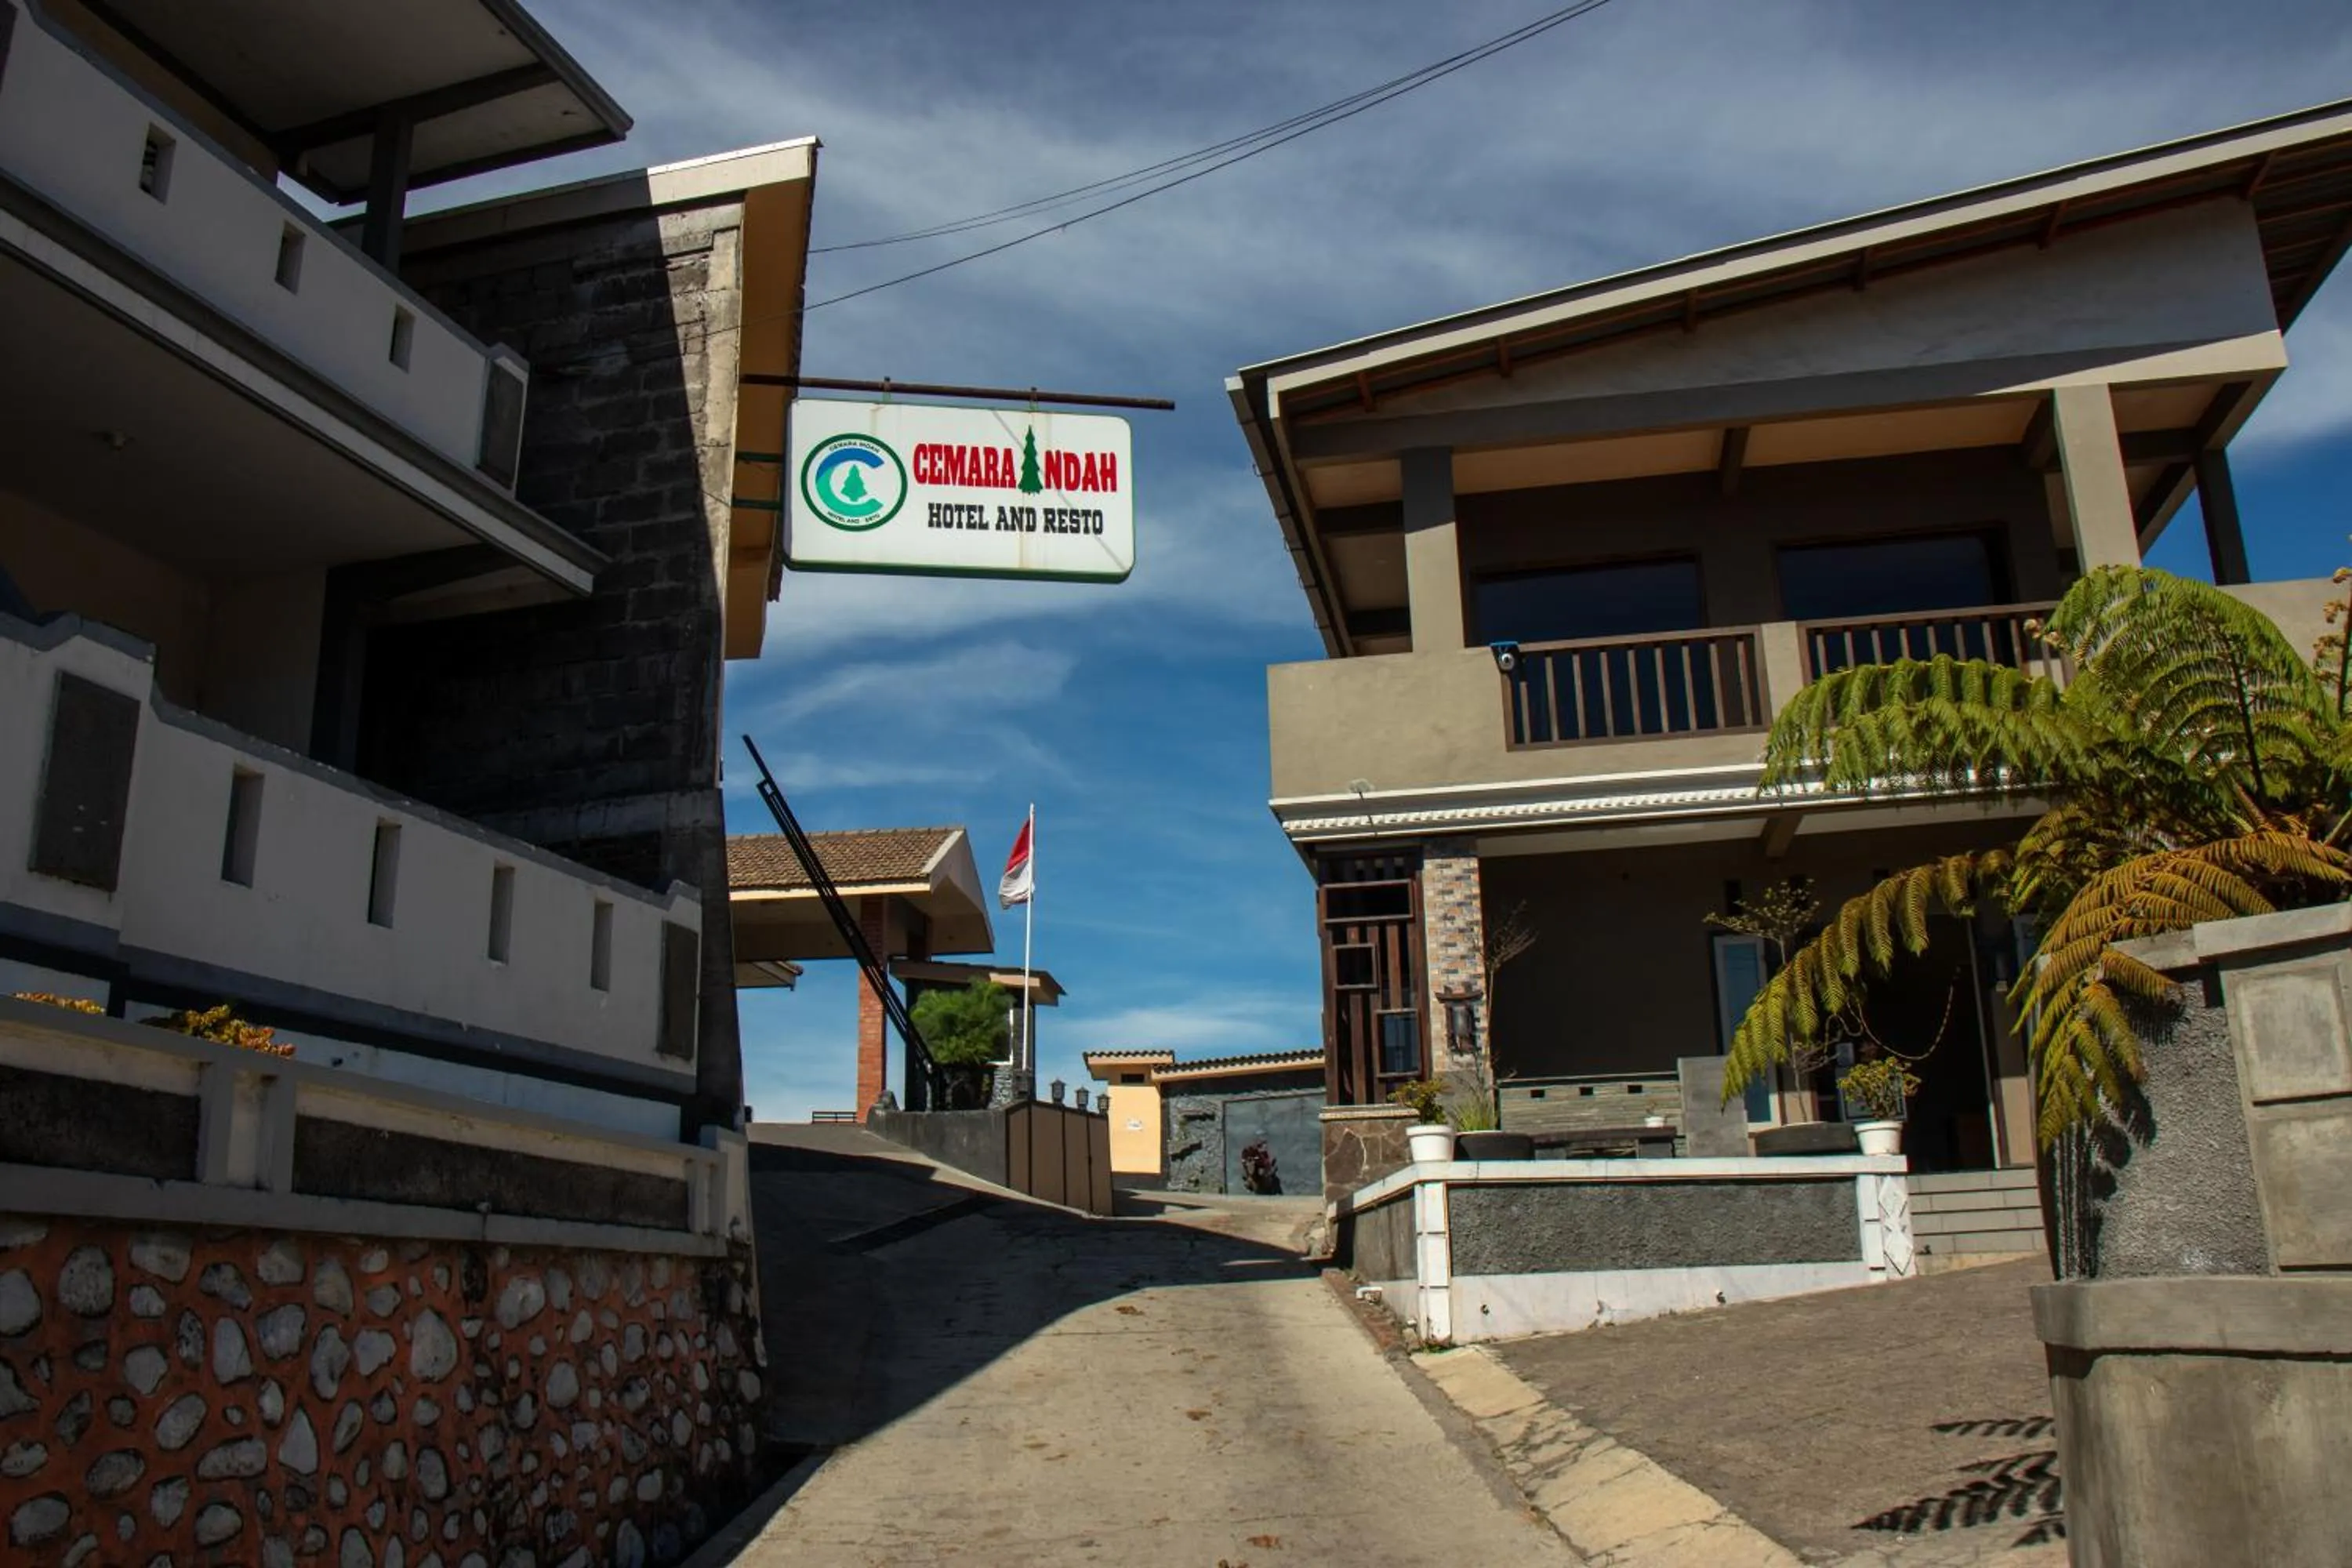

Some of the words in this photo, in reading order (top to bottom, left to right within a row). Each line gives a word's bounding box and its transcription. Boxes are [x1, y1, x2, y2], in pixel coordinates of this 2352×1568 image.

[913, 444, 1017, 489] CEMARA
[927, 503, 989, 530] HOTEL
[995, 506, 1036, 532] AND
[1043, 507, 1103, 535] RESTO
